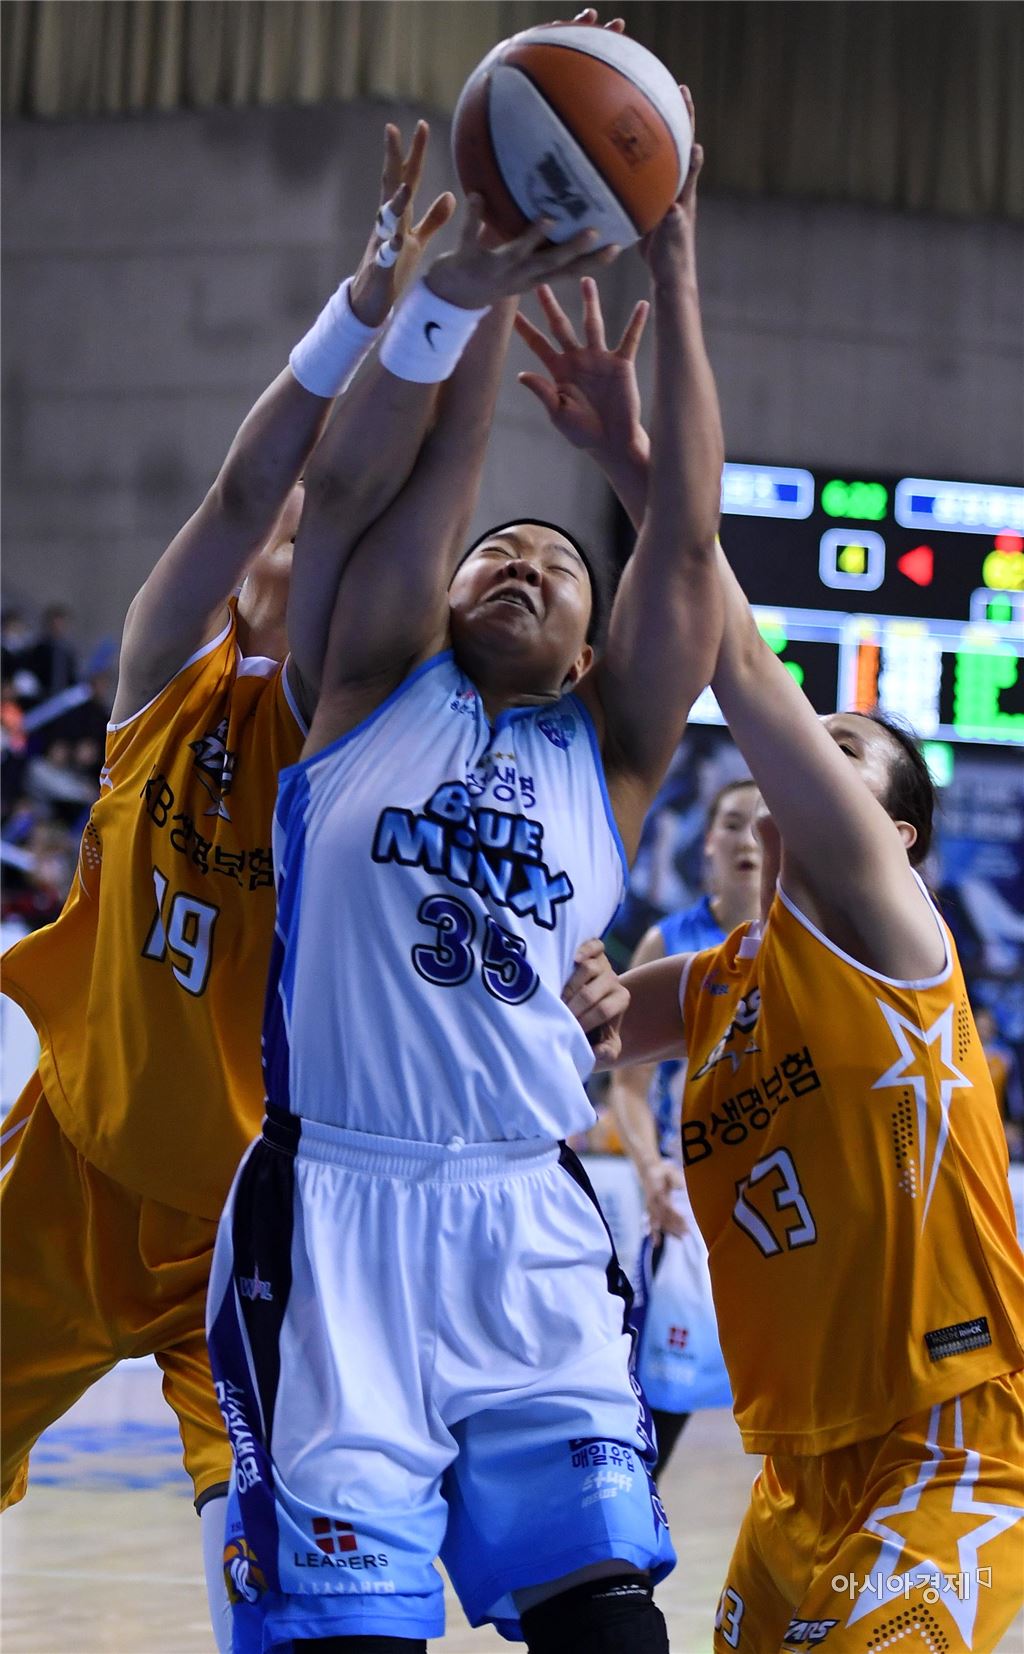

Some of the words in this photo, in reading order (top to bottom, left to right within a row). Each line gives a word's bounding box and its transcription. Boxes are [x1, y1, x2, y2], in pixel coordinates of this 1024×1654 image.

[466, 766, 537, 808] 성생명
[141, 865, 220, 998] 19
[412, 894, 539, 1006] 35
[682, 1046, 821, 1166] B생명보험
[732, 1146, 817, 1258] 13
[571, 1444, 635, 1472] 매일유업
[294, 1552, 389, 1570] LEADERS
